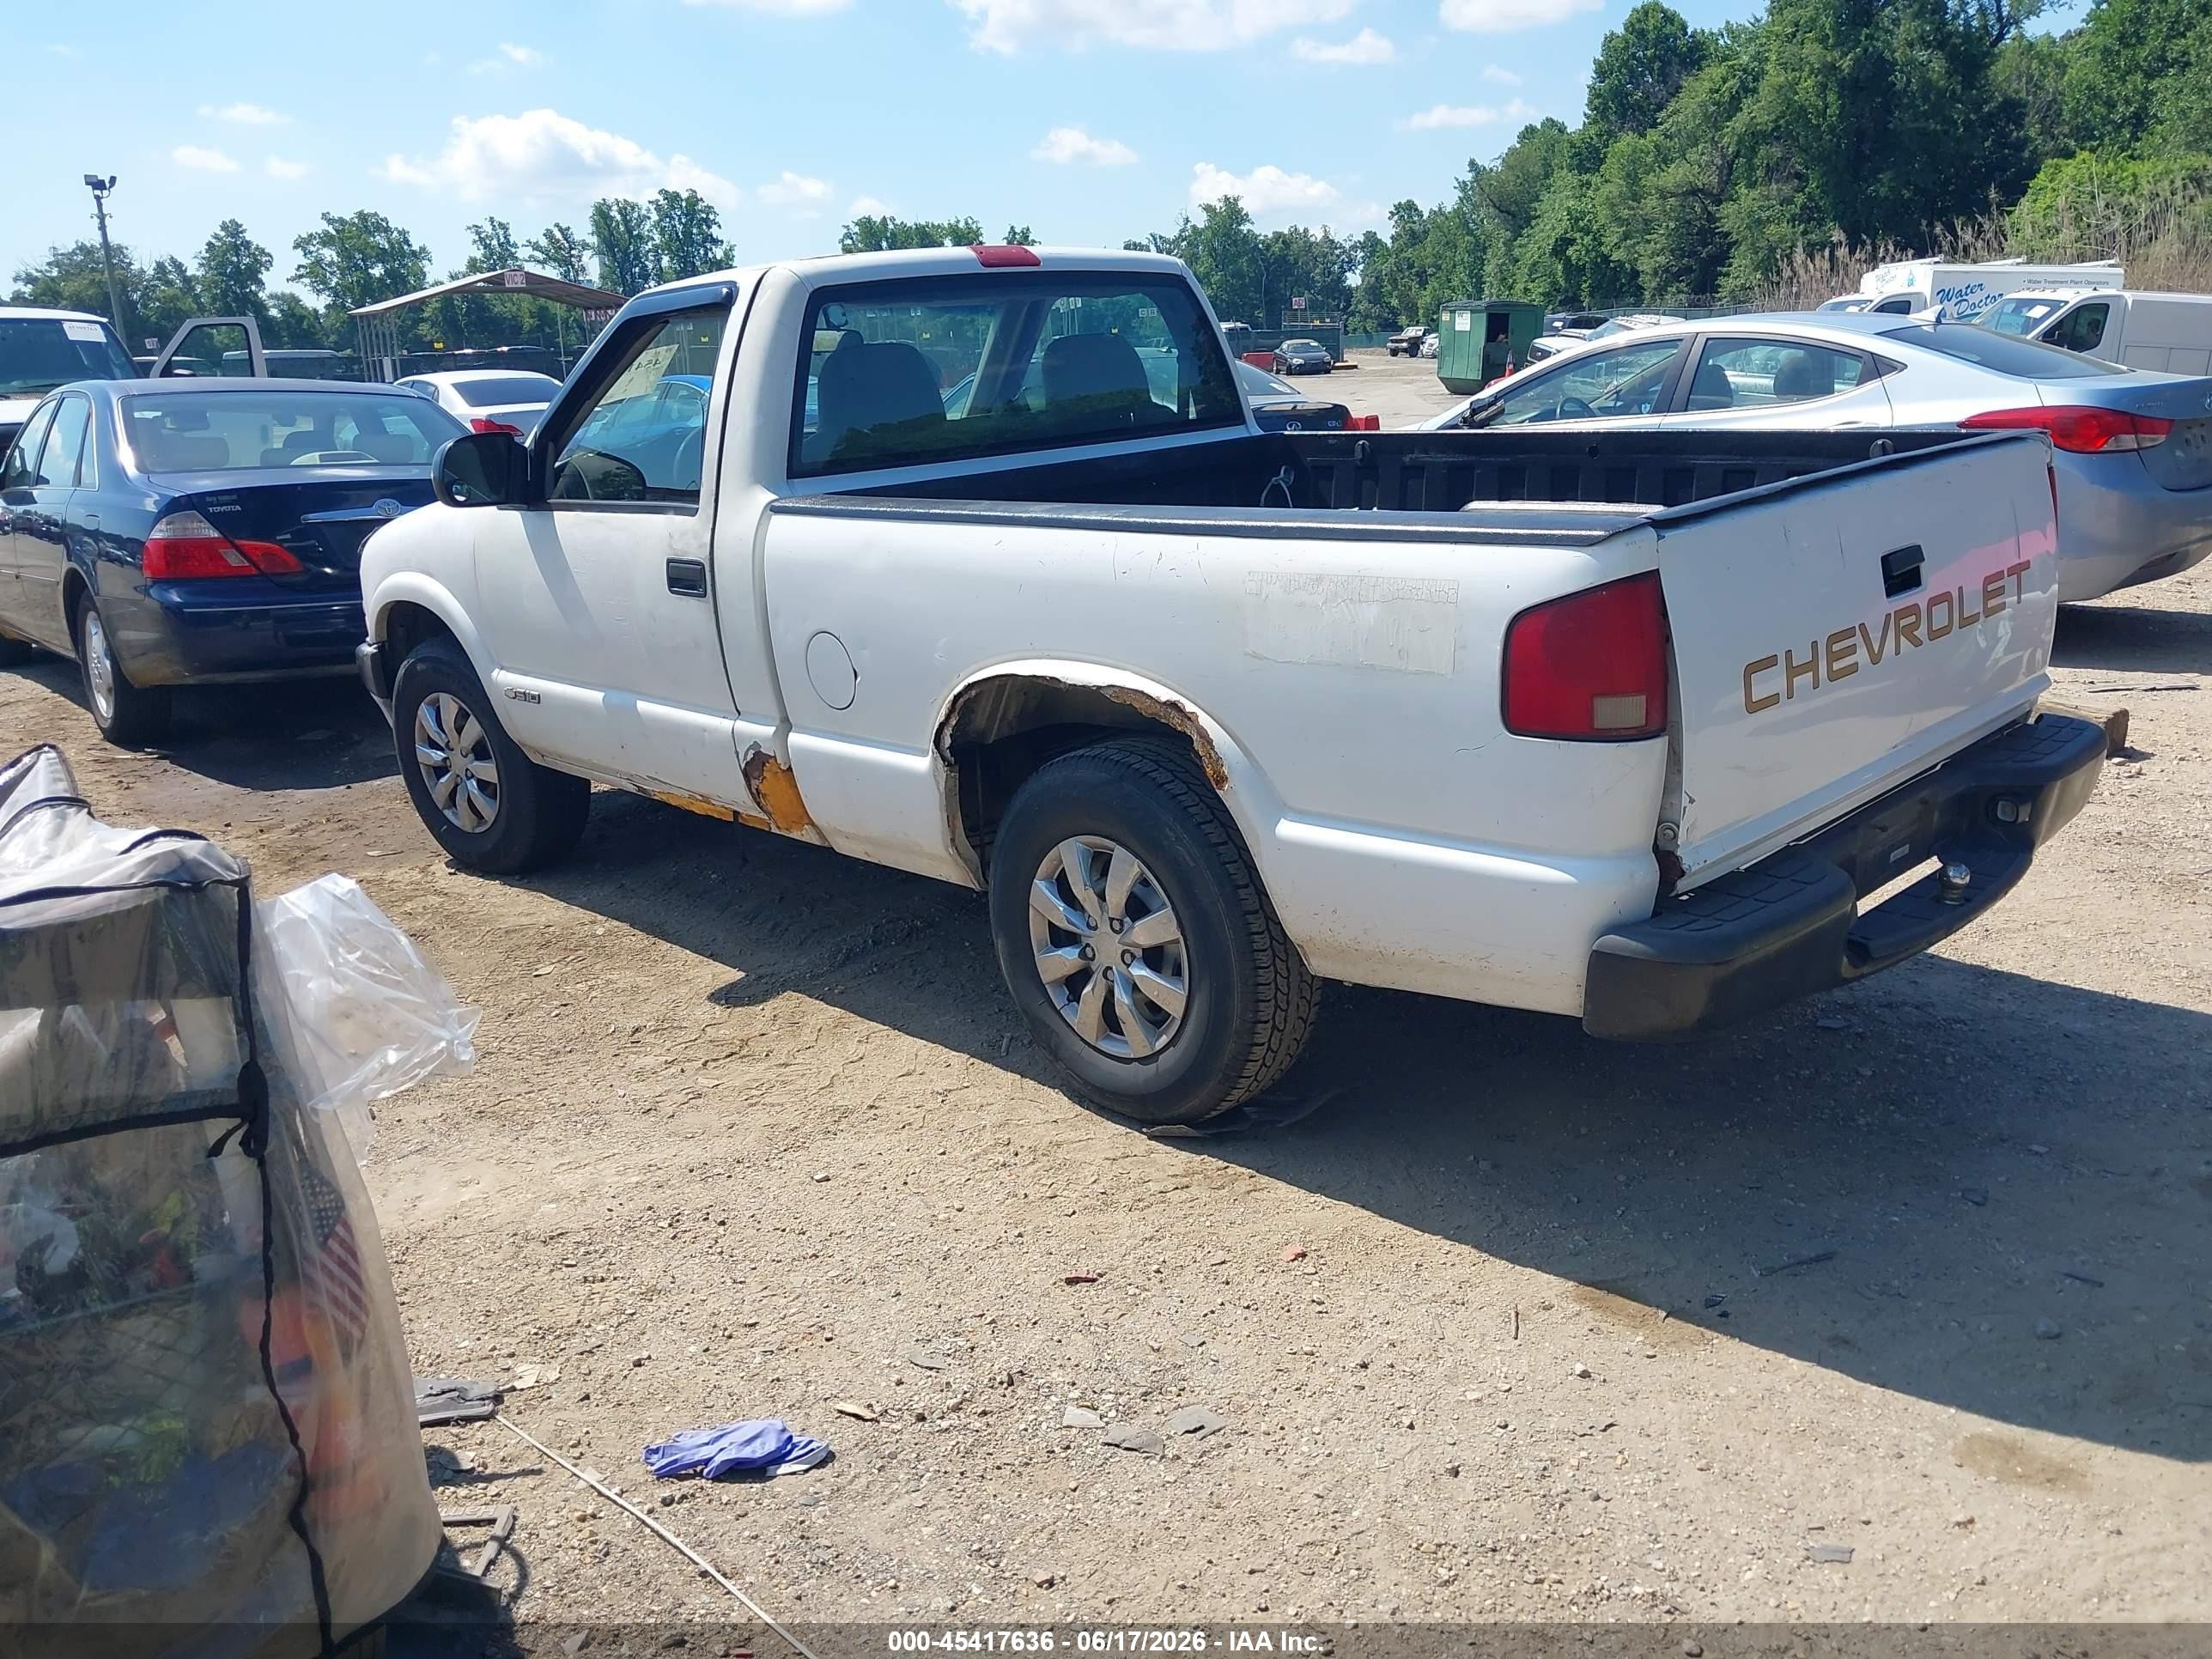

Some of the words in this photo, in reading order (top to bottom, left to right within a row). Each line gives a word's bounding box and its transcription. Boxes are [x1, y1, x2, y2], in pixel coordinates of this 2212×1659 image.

[506, 274, 519, 285] VIC
[520, 274, 526, 285] 2
[1936, 282, 1986, 305] Water
[1954, 293, 2004, 315] Doctor
[208, 505, 241, 514] TOYOTA
[1743, 559, 2031, 714] CHEVROLET
